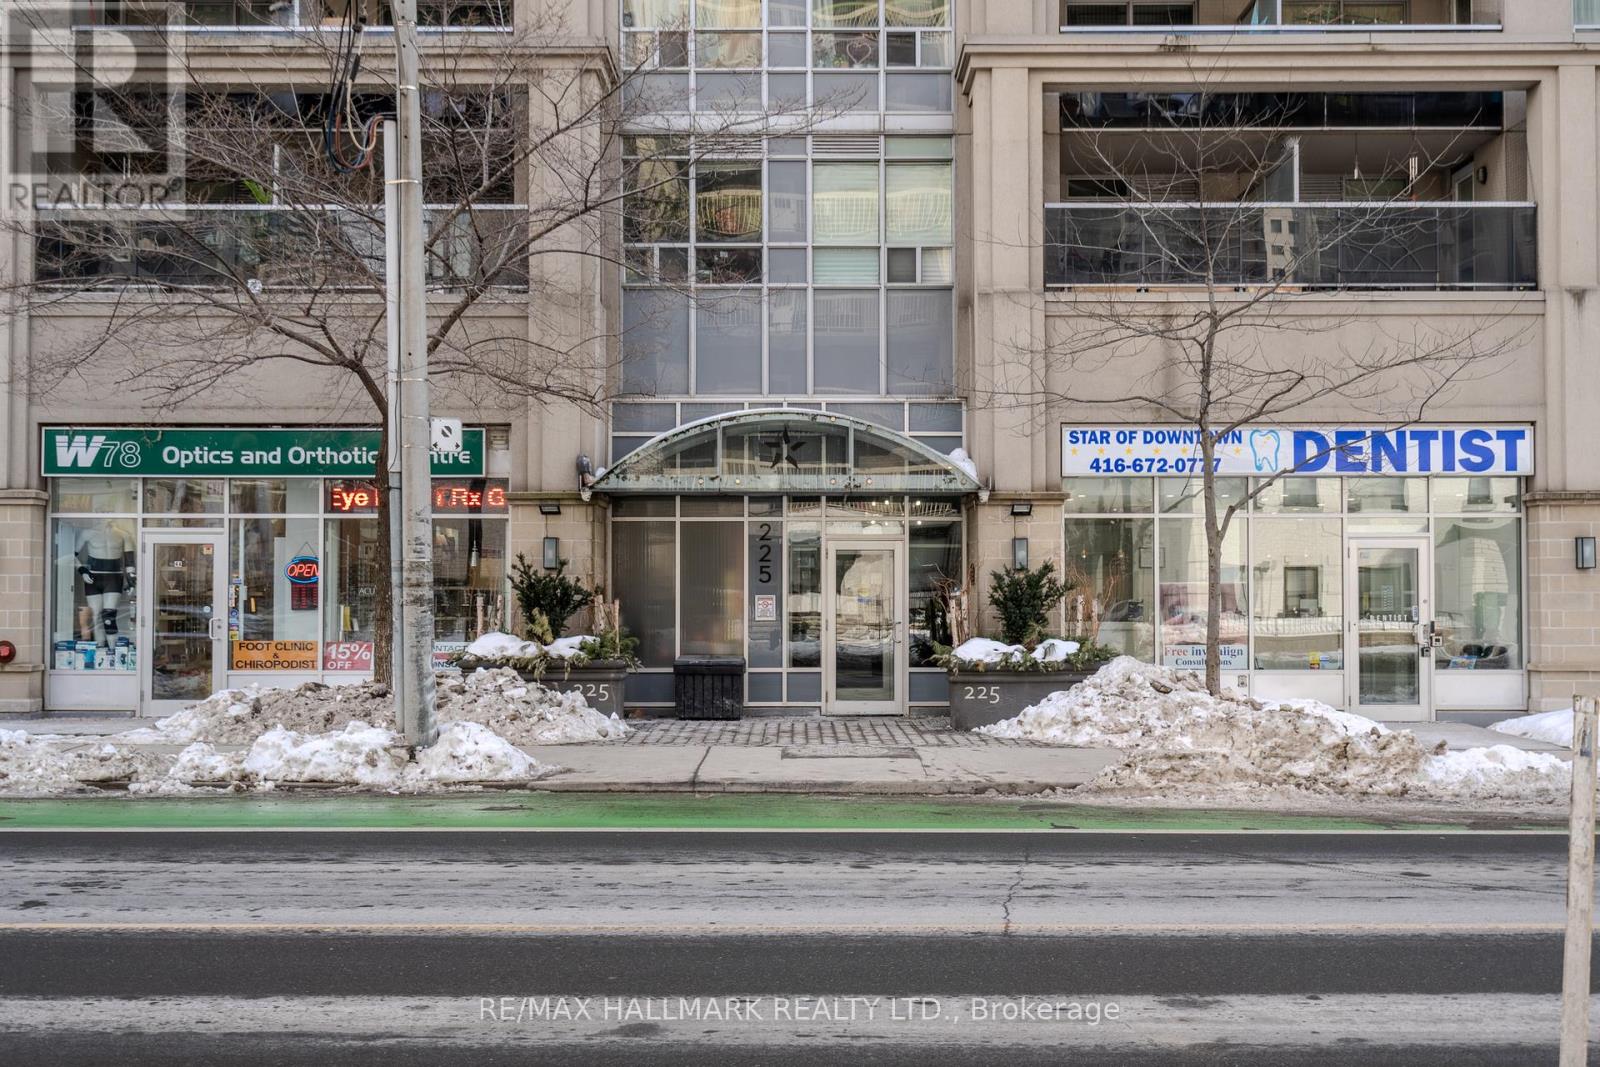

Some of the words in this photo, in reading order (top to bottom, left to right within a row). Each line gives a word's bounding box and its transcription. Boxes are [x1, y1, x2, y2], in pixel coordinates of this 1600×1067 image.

[1069, 430, 1110, 444] STAR
[1116, 430, 1137, 444] OF
[1143, 430, 1242, 444] DOWNTWN
[55, 435, 141, 467] W78
[162, 446, 233, 468] Optics
[240, 446, 280, 465] and
[1293, 429, 1525, 472] DENTIST
[333, 488, 369, 510] Eye
[758, 523, 771, 583] 225
[287, 564, 319, 577] OPEN
[239, 643, 271, 651] FOOT
[275, 643, 314, 651] CLINIC
[327, 643, 370, 660] 15%
[1165, 647, 1188, 656] Free
[235, 660, 316, 669] CHIROPODIST
[327, 661, 353, 669] OFF
[964, 686, 1000, 704] 225
